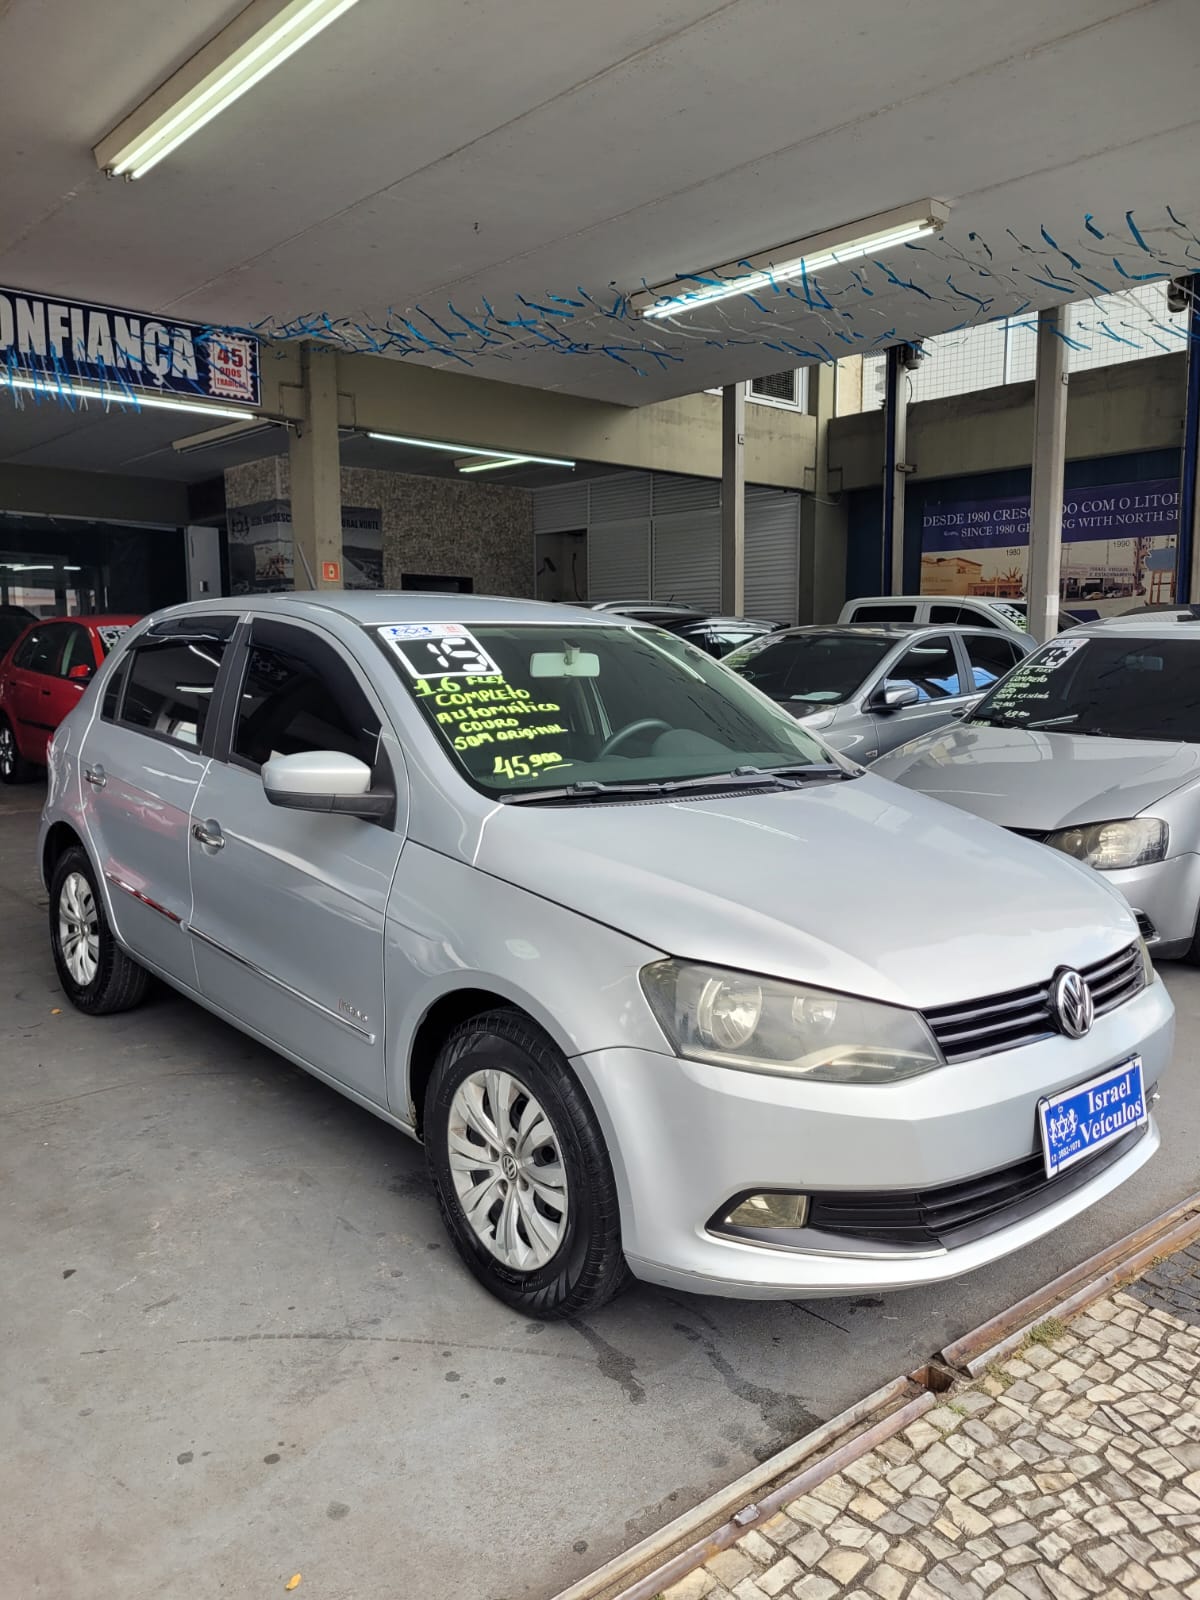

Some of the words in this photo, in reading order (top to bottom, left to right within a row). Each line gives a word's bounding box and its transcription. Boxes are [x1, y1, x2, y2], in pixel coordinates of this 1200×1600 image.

[217, 347, 243, 367] 45
[923, 513, 965, 527] DESDE
[967, 511, 991, 523] 1980
[1081, 498, 1115, 513] COM
[1119, 497, 1131, 509] O
[961, 525, 993, 538] SINCE
[995, 524, 1015, 535] 1980
[1079, 515, 1113, 528] WITH
[1115, 511, 1163, 525] NORTH
[1006, 548, 1021, 556] 1980
[427, 638, 488, 672] 15
[414, 676, 461, 697] 1.6
[465, 675, 506, 685] FLEX
[459, 718, 520, 733] COURO
[454, 732, 495, 751] SOM
[1087, 1073, 1132, 1115] Israel
[1079, 1100, 1142, 1145] Veículos
